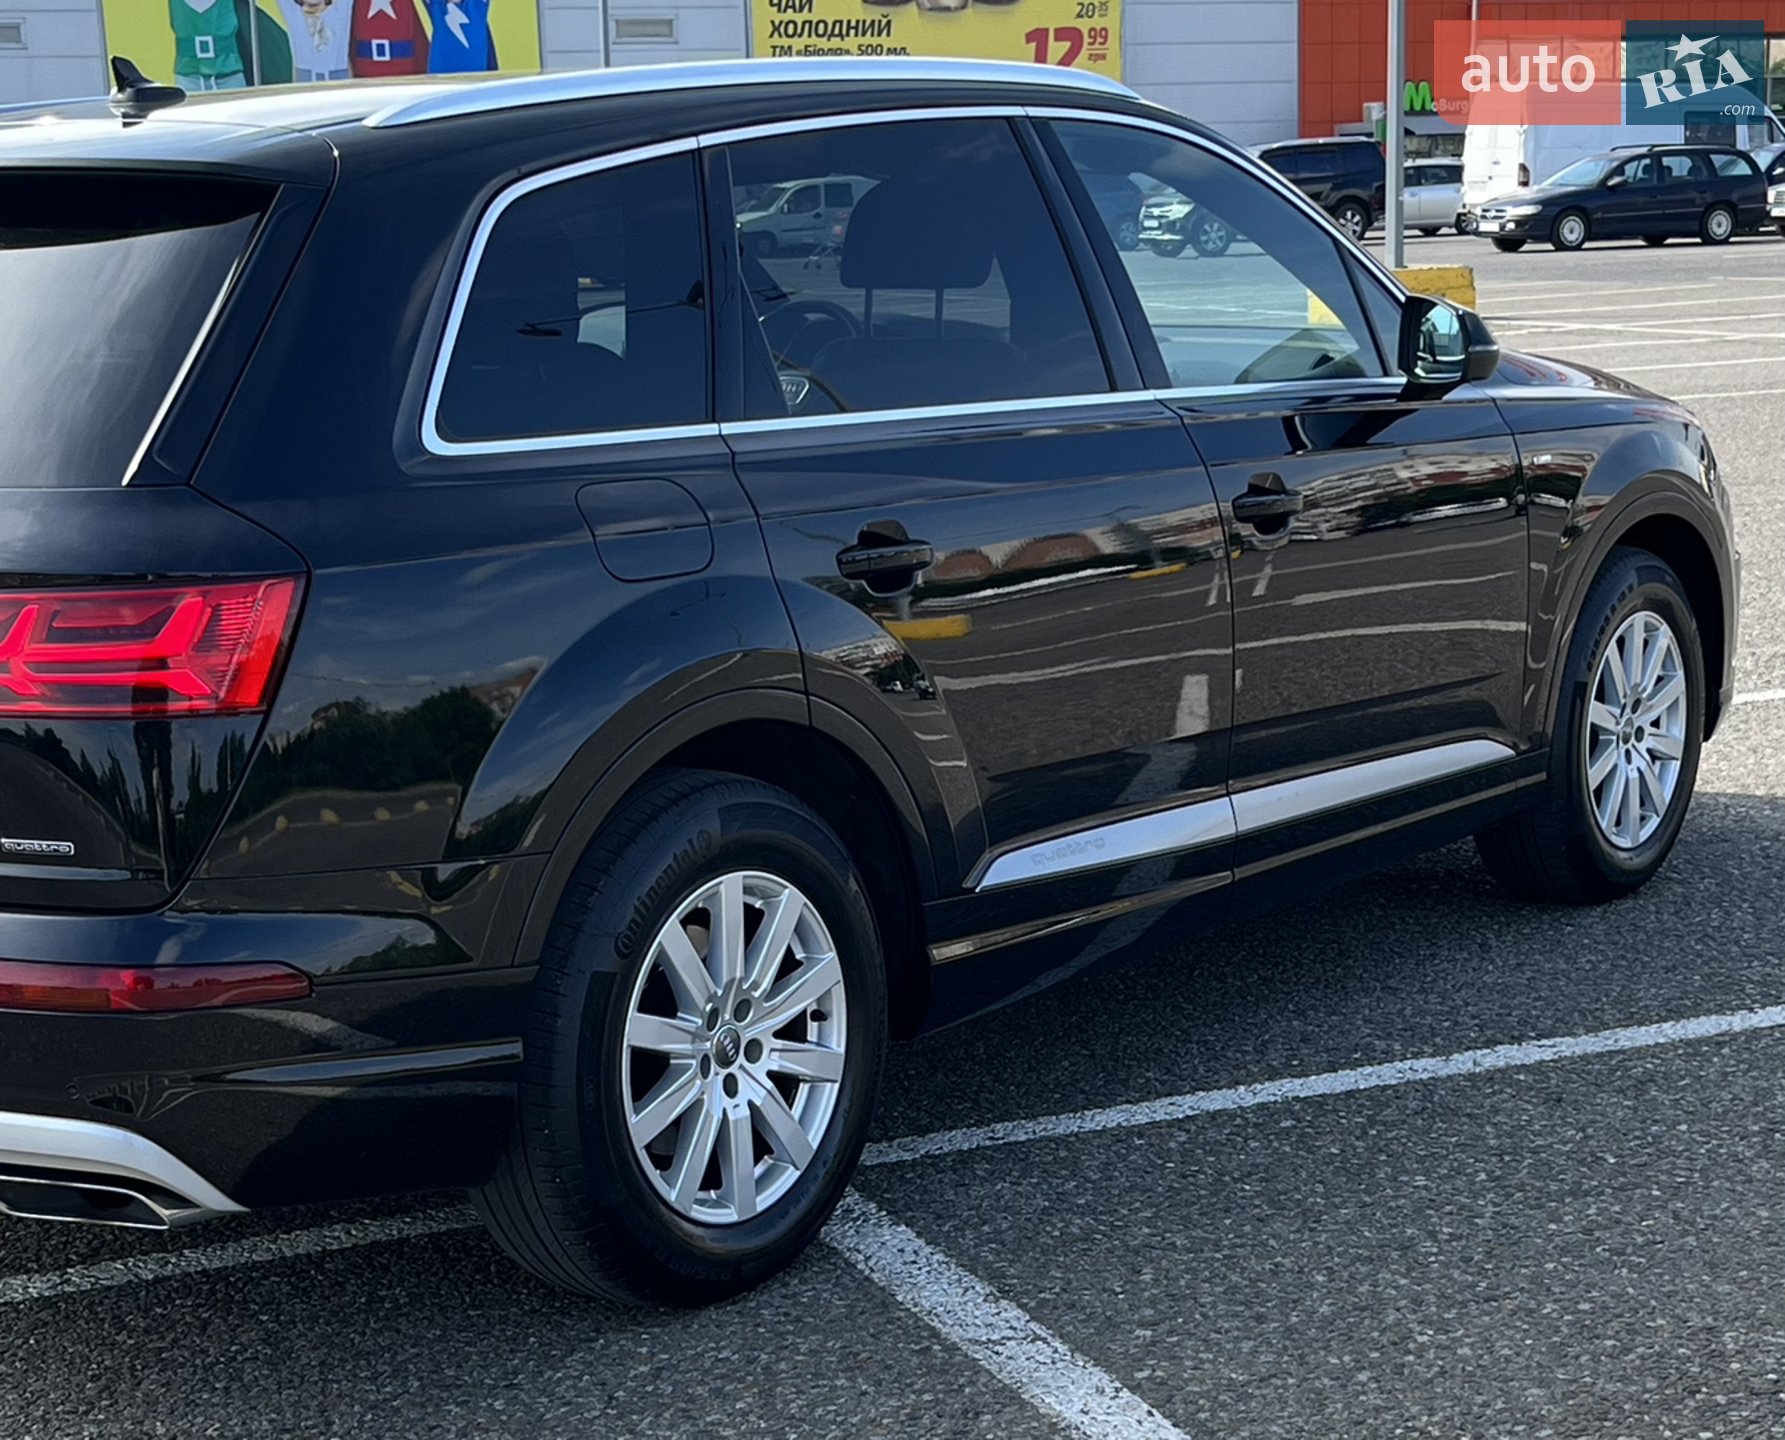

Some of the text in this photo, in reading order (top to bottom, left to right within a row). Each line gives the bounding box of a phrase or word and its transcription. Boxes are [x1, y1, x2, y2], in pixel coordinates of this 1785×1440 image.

[1074, 2, 1096, 19] 20
[768, 14, 892, 41] ХОЛОДНИЙ
[770, 45, 793, 57] ТМ
[857, 44, 884, 56] 500
[1025, 26, 1109, 67] 12 99
[4, 841, 71, 853] quattro
[1030, 837, 1106, 867] quattro
[613, 836, 703, 961] Continental
